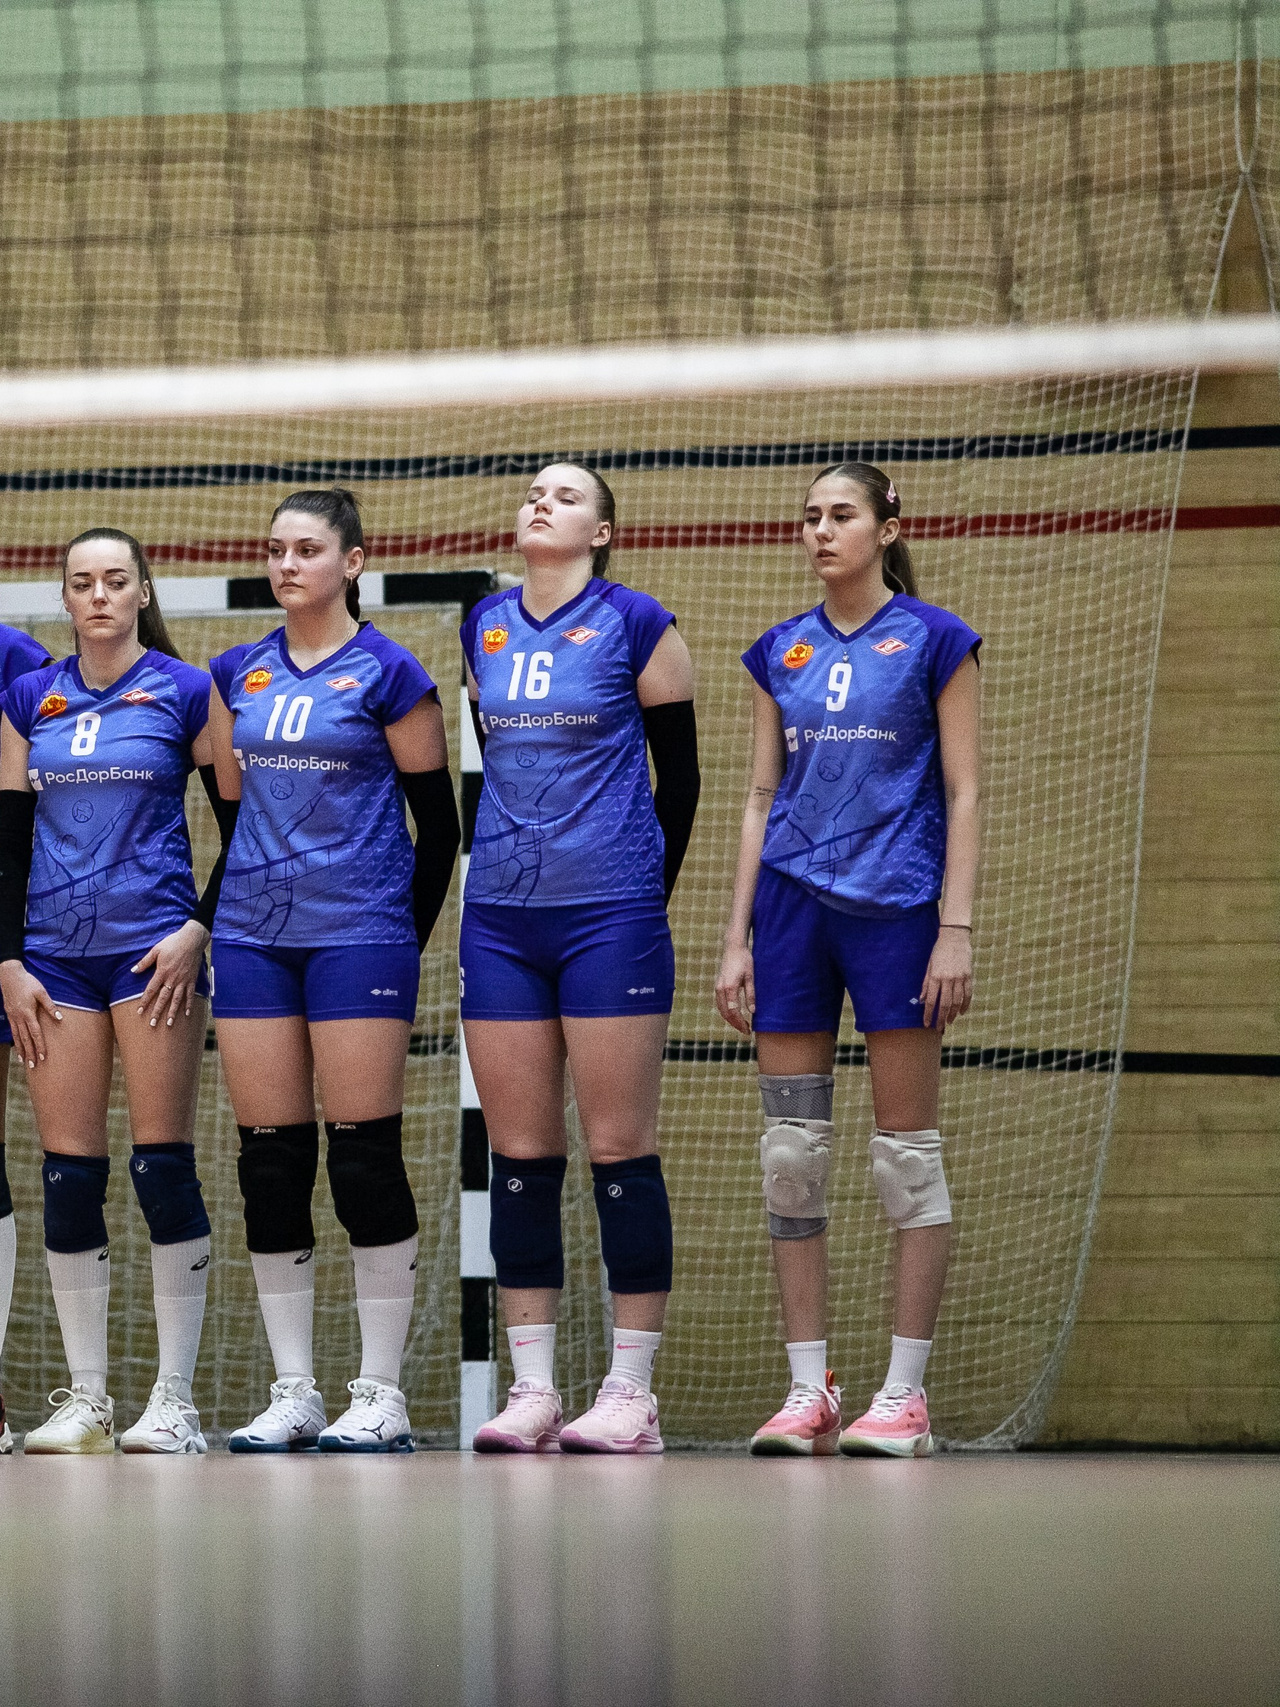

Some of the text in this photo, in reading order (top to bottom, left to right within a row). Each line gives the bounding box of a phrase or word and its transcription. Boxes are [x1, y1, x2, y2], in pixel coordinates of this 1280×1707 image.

[507, 651, 554, 701] 16
[826, 662, 853, 712] 9
[71, 712, 101, 757] 8
[264, 694, 314, 742] 10
[489, 712, 598, 731] РосДорБанк
[45, 766, 154, 785] РосДорБанк
[249, 754, 350, 771] РосДорБанк
